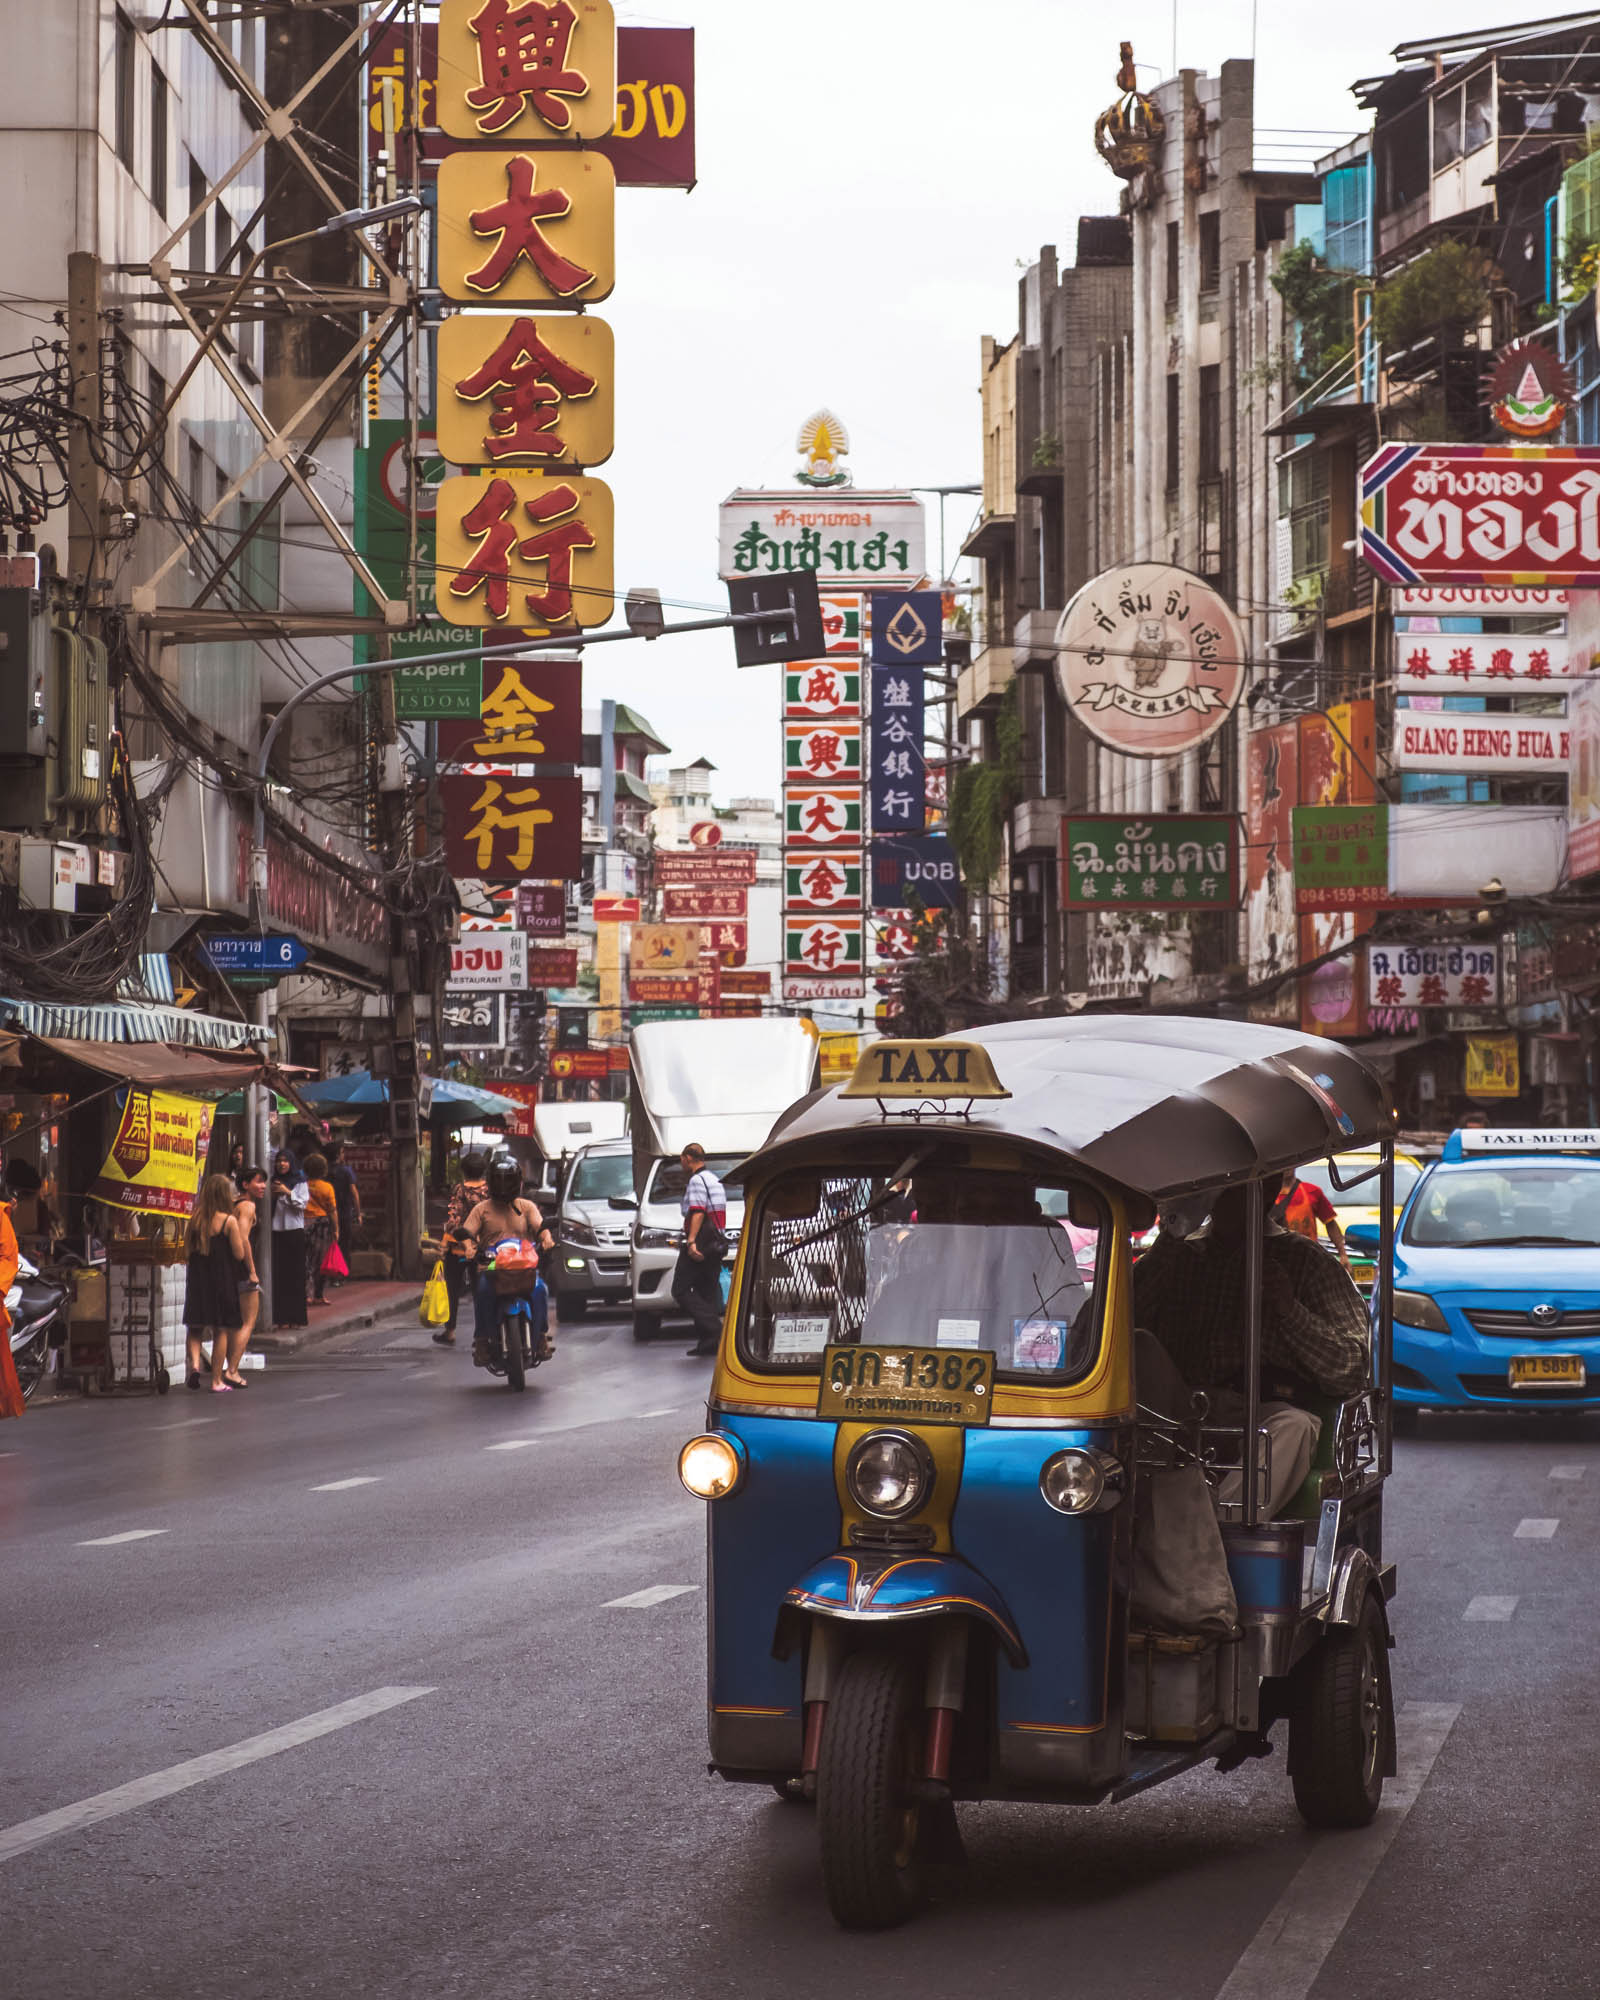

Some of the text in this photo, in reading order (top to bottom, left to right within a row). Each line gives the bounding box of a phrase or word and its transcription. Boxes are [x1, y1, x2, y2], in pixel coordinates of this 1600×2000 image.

[1412, 460, 1544, 497] ห้างทอง
[1405, 646, 1569, 683] 林祥興藥
[879, 676, 915, 819] 盤谷銀行
[1404, 727, 1459, 756] SIANG
[1463, 729, 1513, 758] HENG
[905, 862, 954, 881] UOB
[279, 943, 293, 961] 6
[873, 1048, 970, 1083] TAXI
[1481, 1134, 1597, 1145] TAXI-METER
[902, 1353, 986, 1393] 1382
